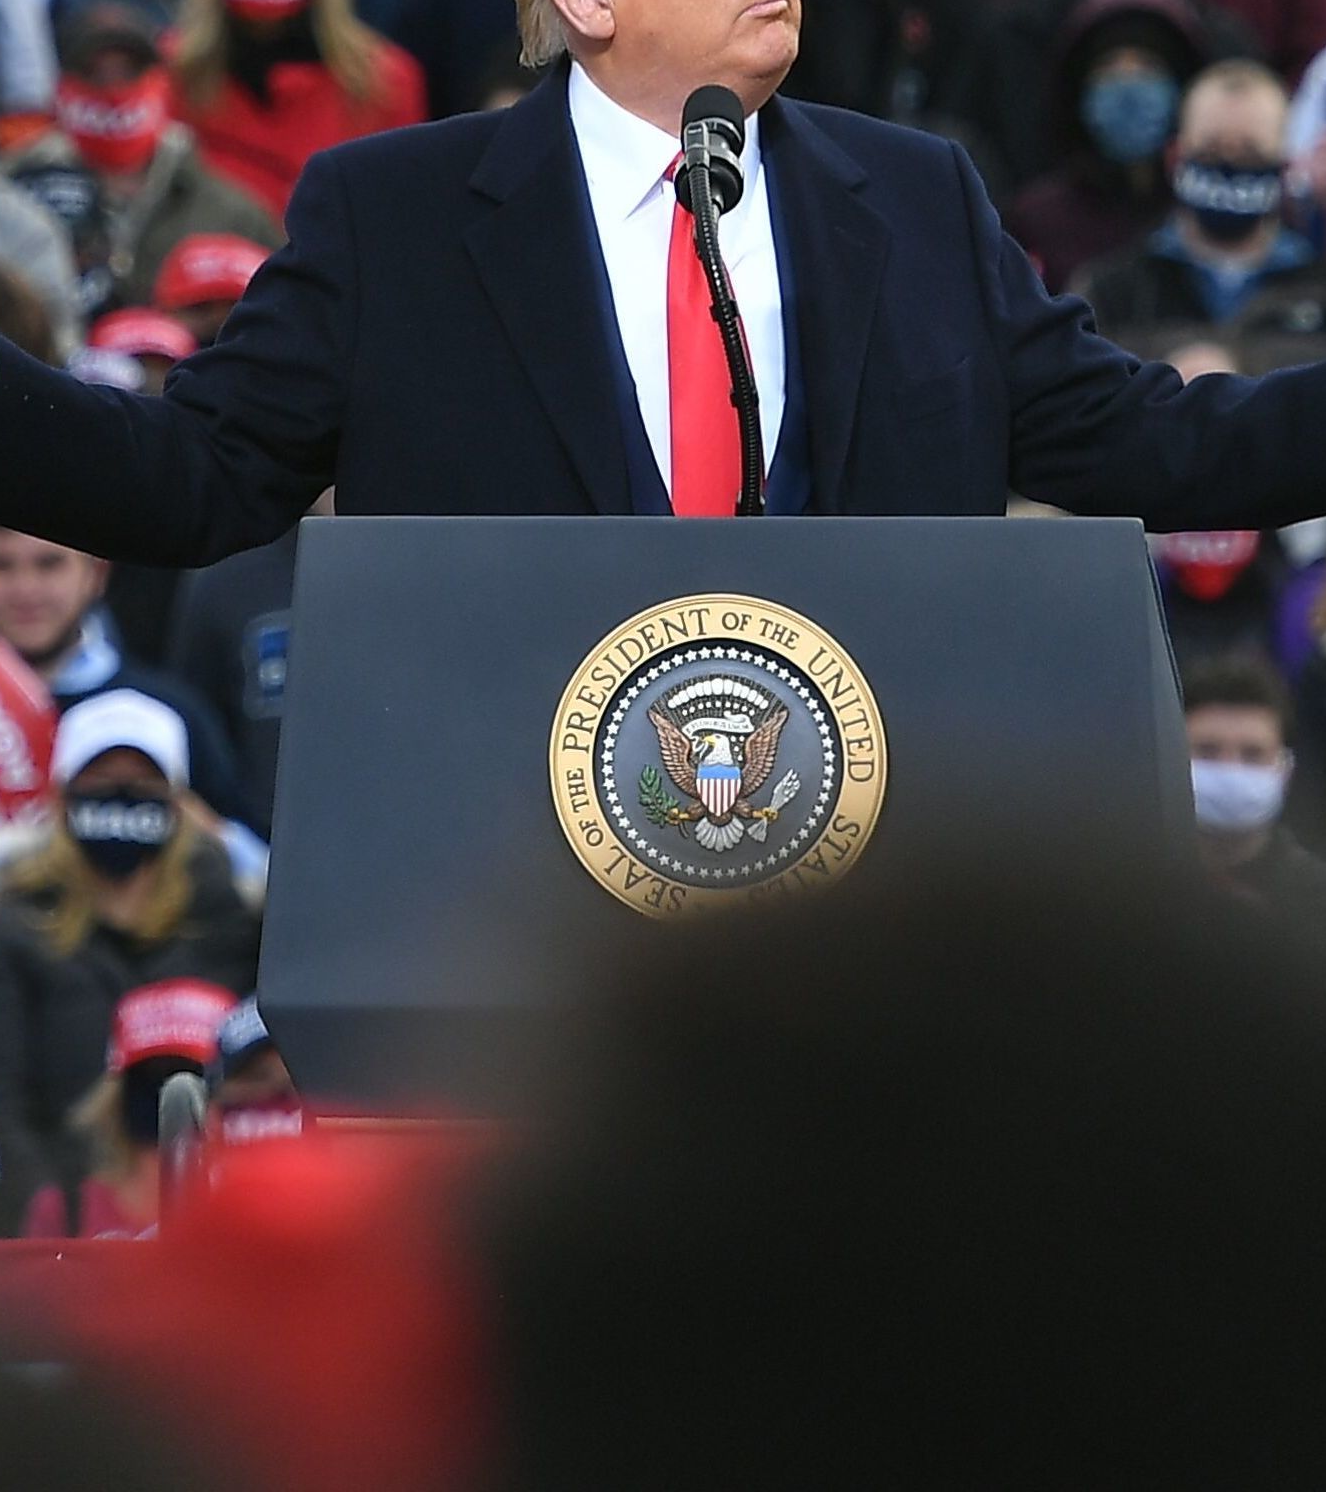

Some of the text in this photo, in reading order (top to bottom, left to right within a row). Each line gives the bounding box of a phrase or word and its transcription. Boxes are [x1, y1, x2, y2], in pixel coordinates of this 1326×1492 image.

[721, 611, 753, 632] OF
[758, 618, 801, 651] THE
[562, 608, 711, 755] PRESIDENT
[807, 646, 876, 783] UNITED
[565, 768, 590, 813] THE
[578, 819, 605, 847] OF
[603, 845, 687, 913] SEAL
